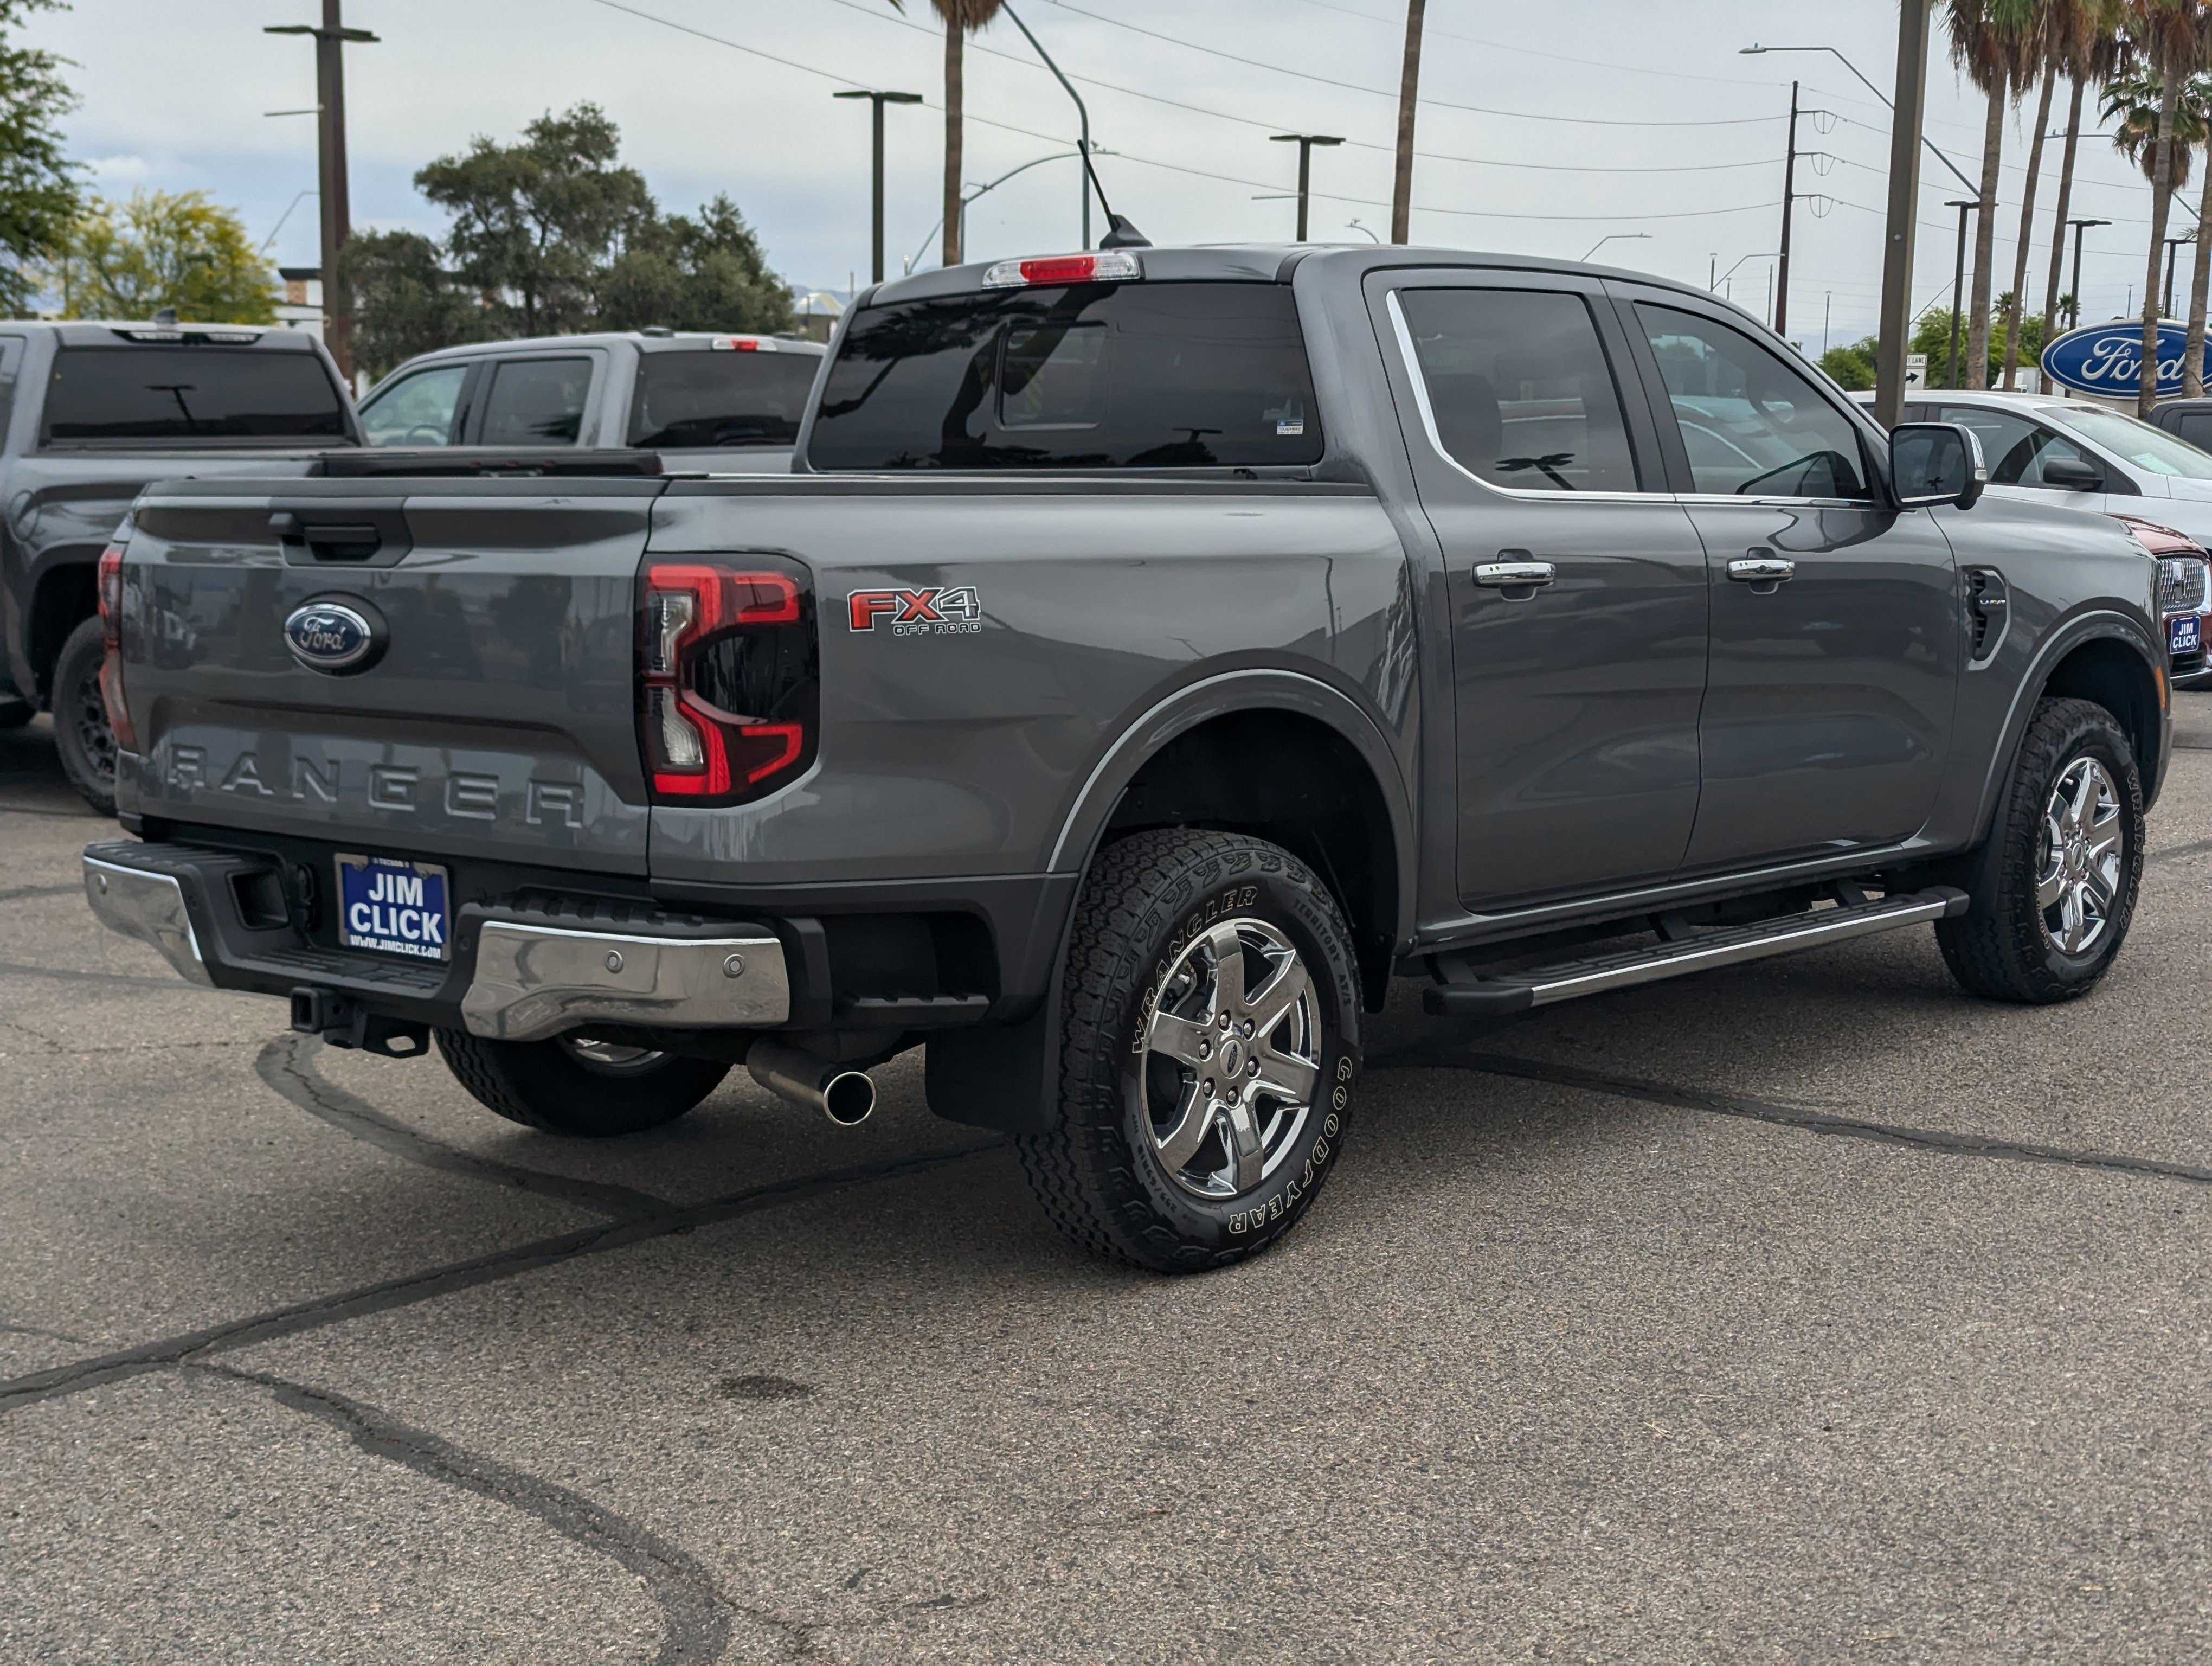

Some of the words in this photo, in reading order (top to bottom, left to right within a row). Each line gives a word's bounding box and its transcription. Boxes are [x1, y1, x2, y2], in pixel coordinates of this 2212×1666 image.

[847, 586, 981, 632] FX4
[299, 616, 346, 650] Ford
[893, 624, 929, 636] OFF
[935, 623, 981, 635] ROAD
[2172, 634, 2197, 649] CLICK
[2178, 622, 2194, 636] JIM
[166, 743, 585, 829] RANGER
[368, 872, 423, 907] JIM
[350, 902, 443, 944] CLICK
[1293, 898, 1342, 962] TERRITORY
[349, 934, 442, 959] WWW.JIMCLICK.COM
[1131, 886, 1257, 1054] WRANGLER
[1229, 1056, 1352, 1234] GOODYEAR
